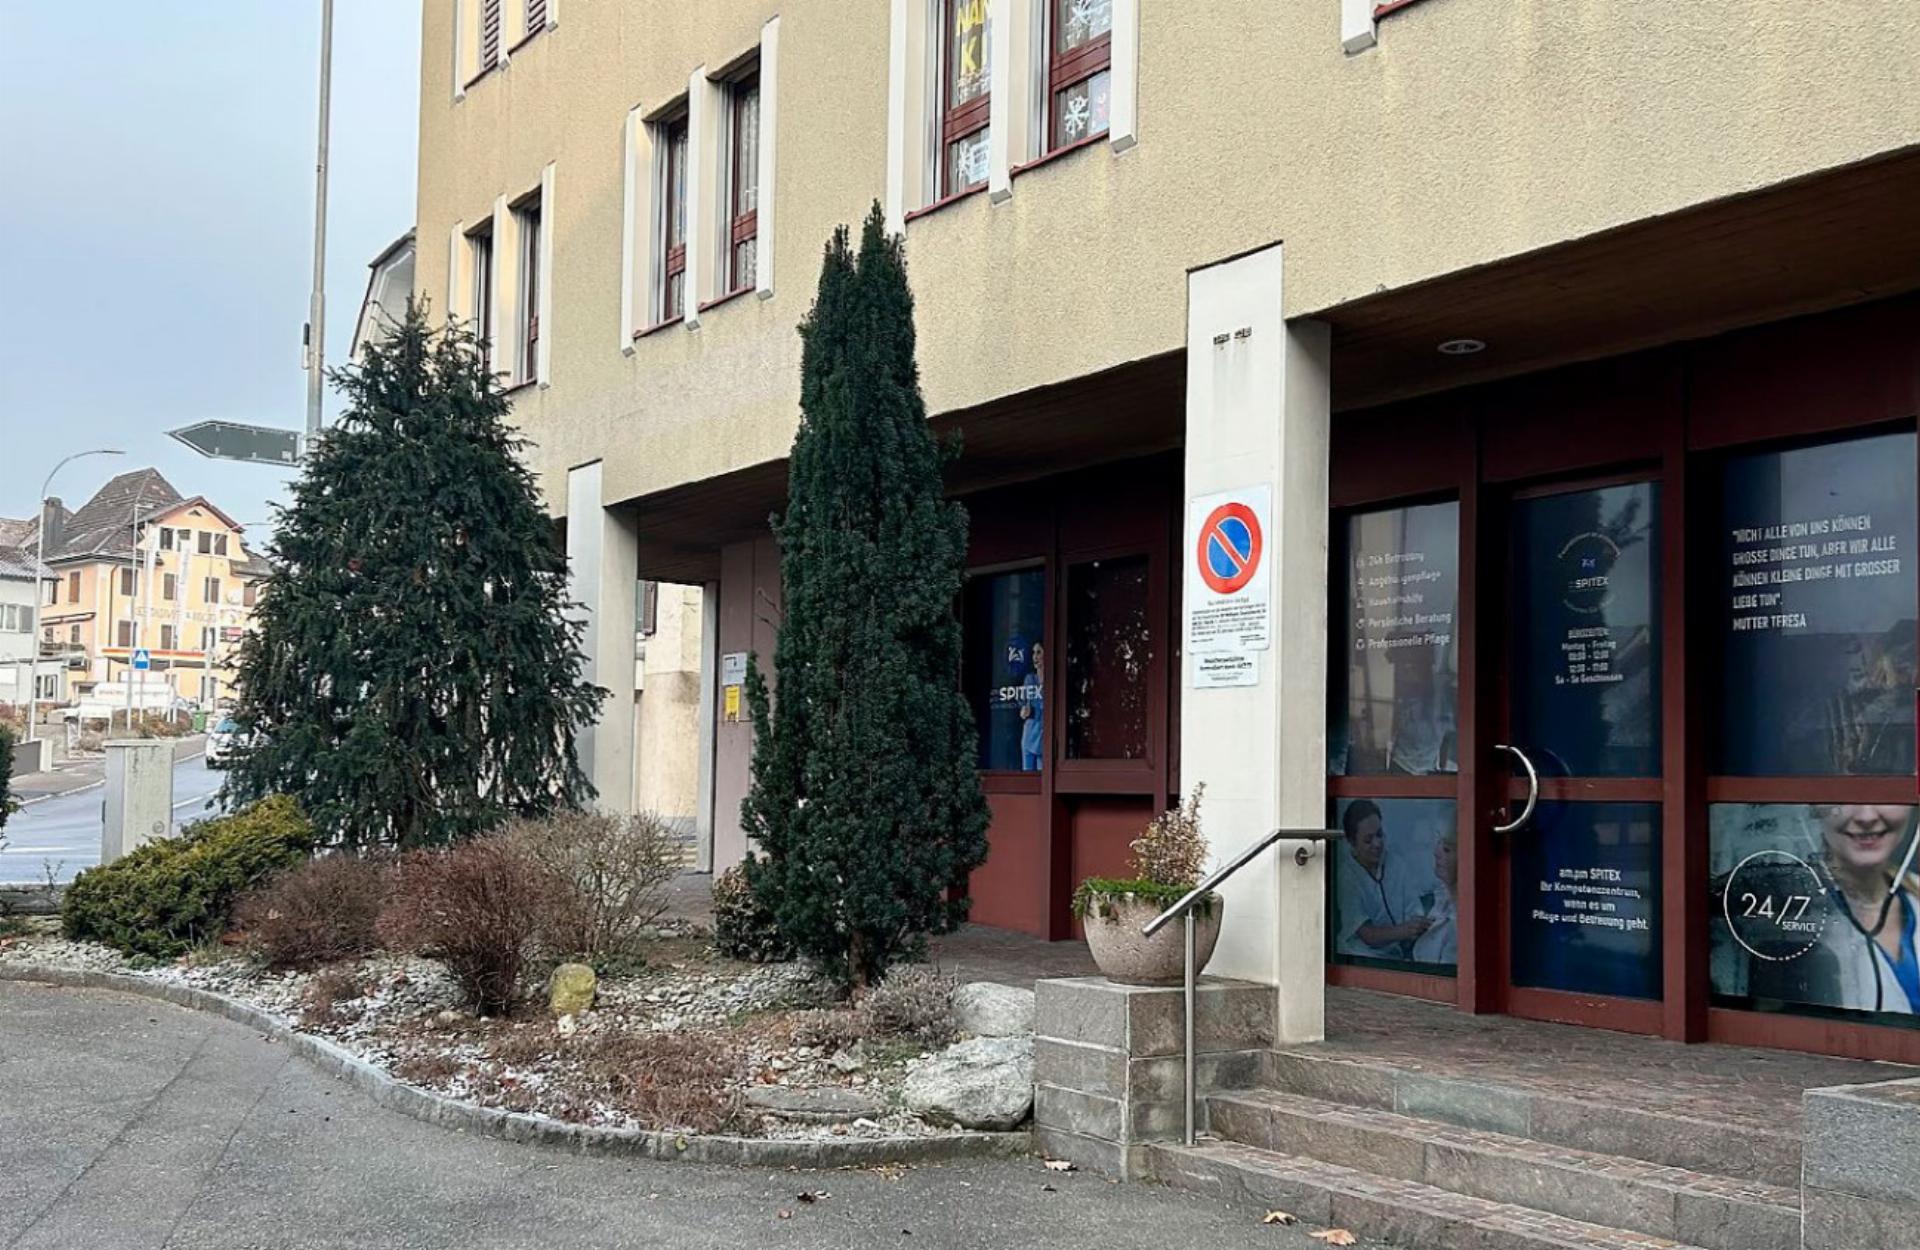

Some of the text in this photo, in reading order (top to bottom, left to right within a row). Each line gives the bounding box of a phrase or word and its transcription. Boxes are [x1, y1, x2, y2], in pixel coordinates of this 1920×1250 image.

[1764, 525, 1788, 539] ALLE
[1788, 523, 1807, 537] VON
[1810, 520, 1829, 534] UNS
[1831, 514, 1871, 532] KÖNNEN
[1733, 536, 1896, 565] GROSSE DINGE TUN, ABER WIR ALLE
[1733, 559, 1900, 587] KÖNNEN KLEINE DINGE MIT GROSSER
[1575, 576, 1609, 588] SPITEX
[1733, 593, 1757, 609] LIEBE
[1415, 612, 1452, 626] Beratung
[1733, 613, 1807, 631] MUTTER TERESA
[1368, 634, 1451, 649] Professionelle Pflege
[999, 685, 1043, 701] SPITEX
[1590, 868, 1621, 881] SPITEX
[1540, 881, 1641, 899] Ihr Kompetenzzentrum,
[1563, 899, 1615, 911] wenn es um
[1741, 892, 1811, 925] 24/7
[1532, 910, 1649, 931] Pflege und Betreuung geht.
[1782, 921, 1817, 933] SERVICE
